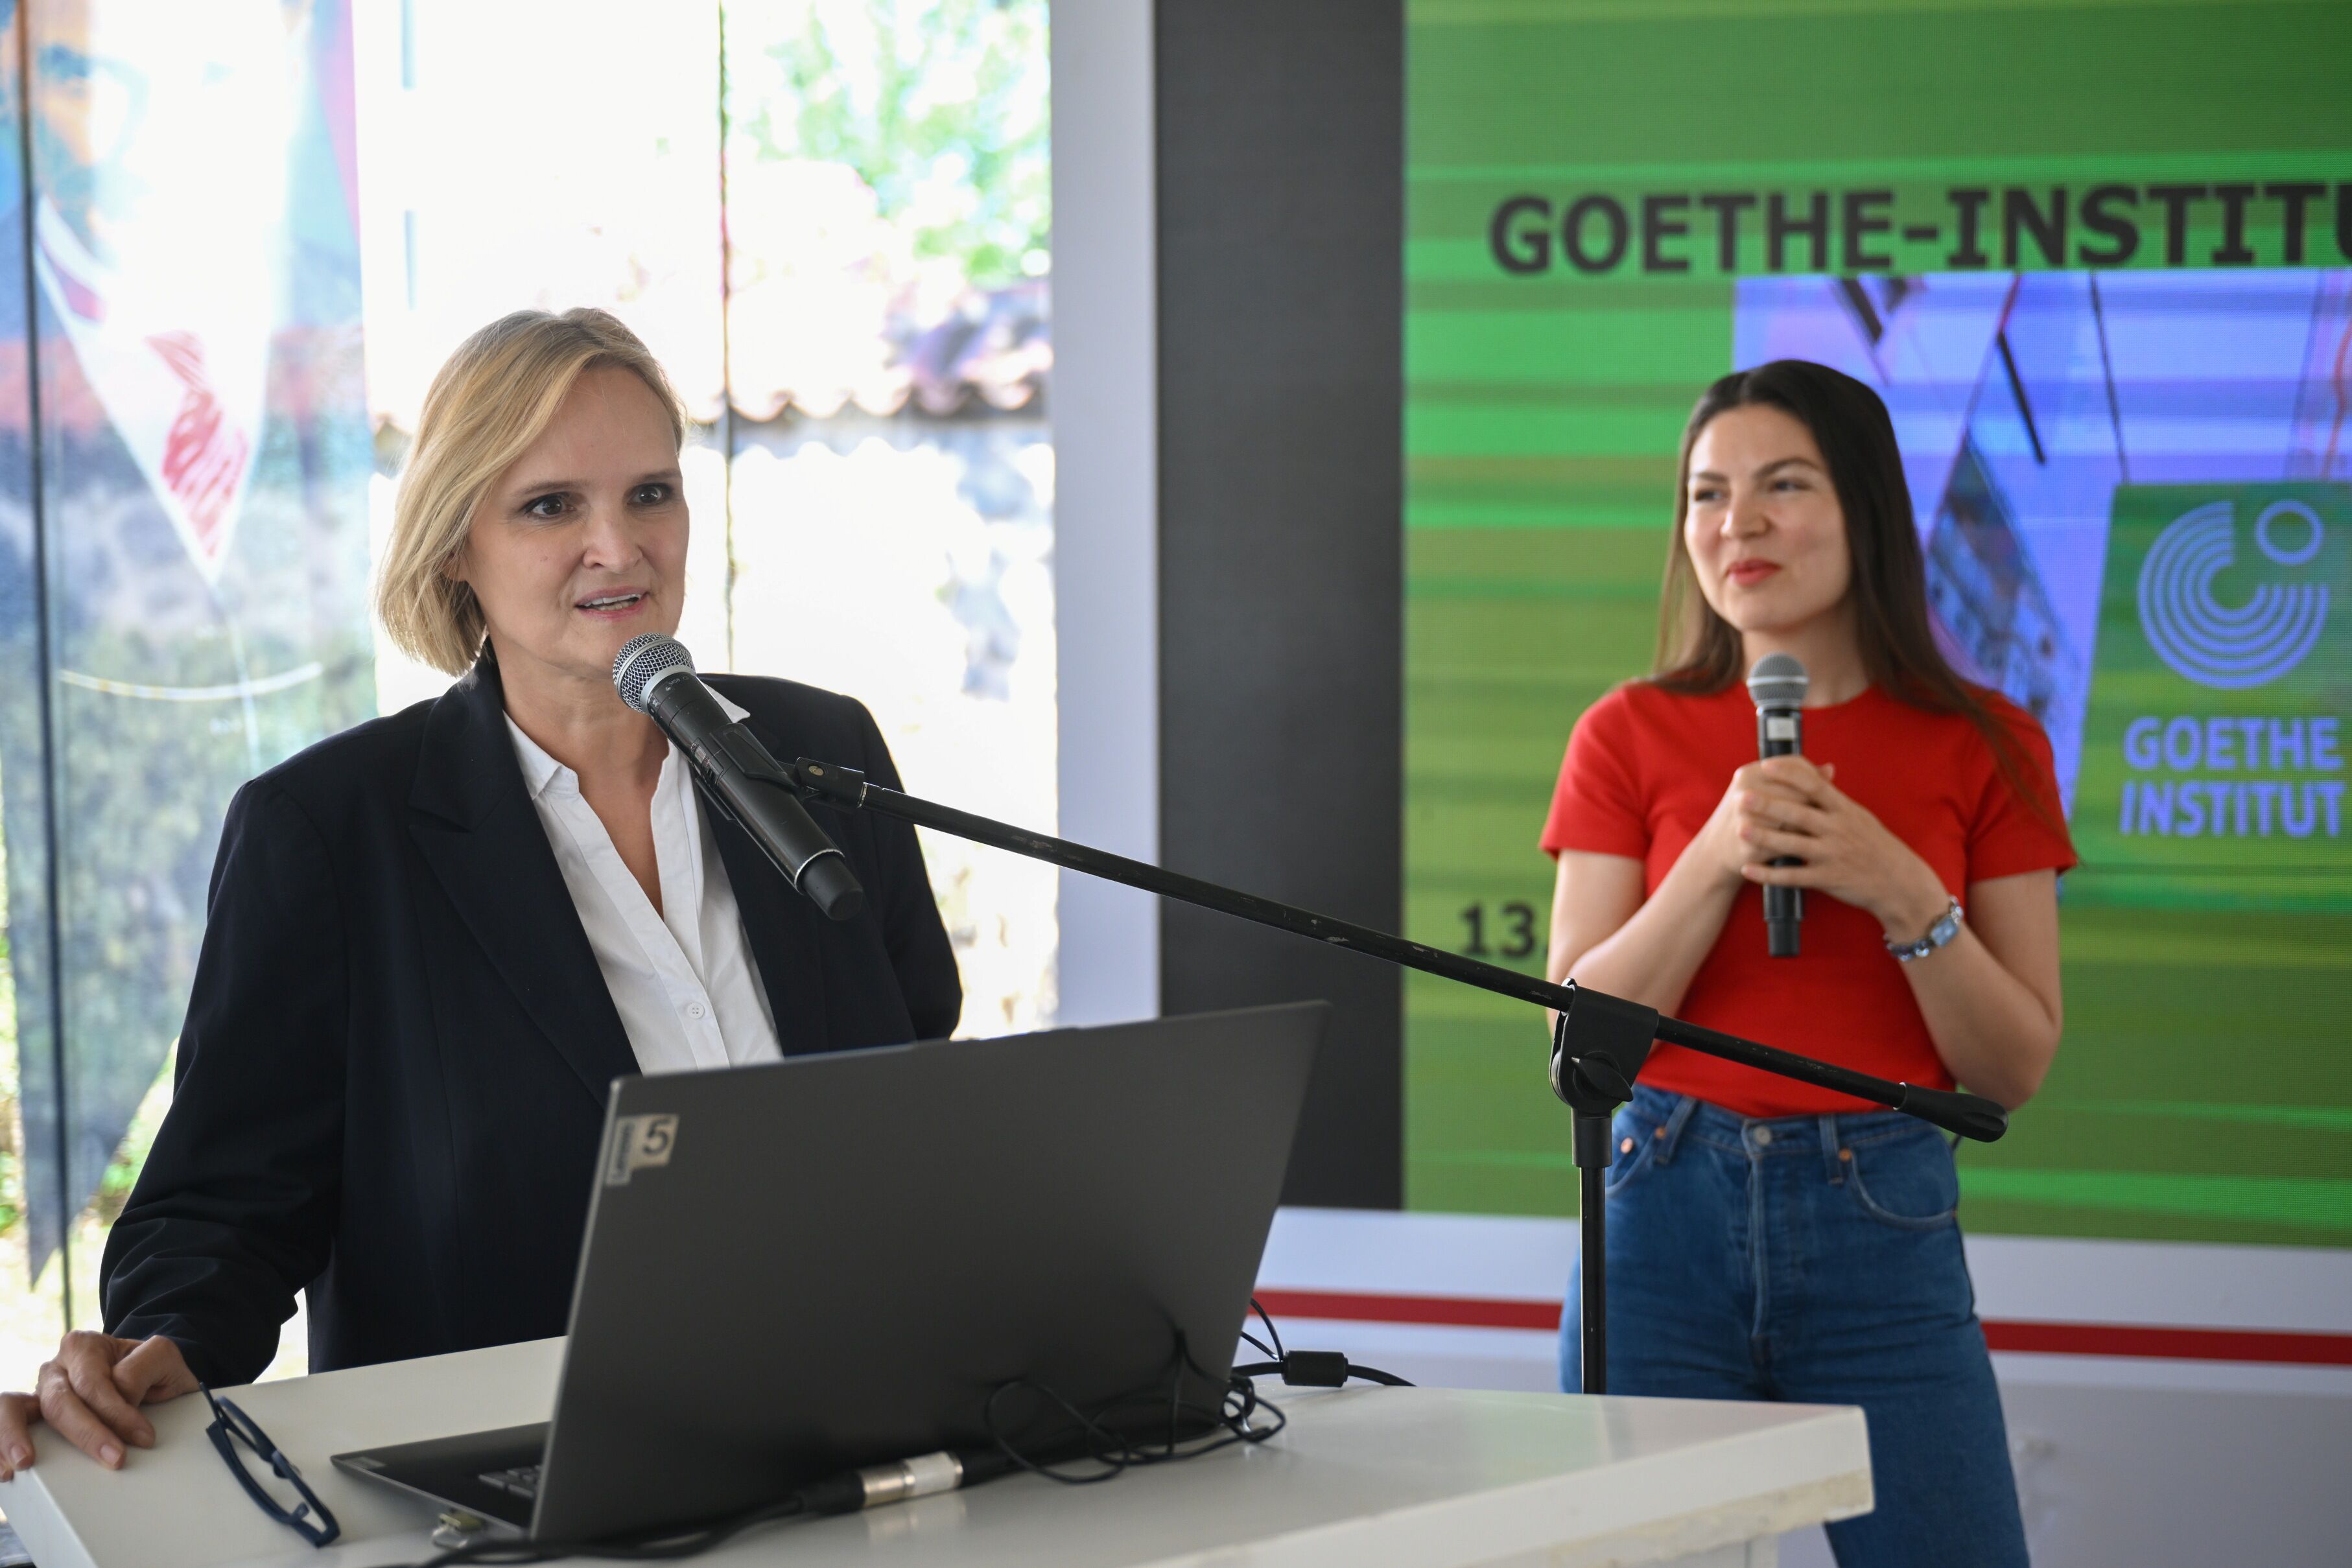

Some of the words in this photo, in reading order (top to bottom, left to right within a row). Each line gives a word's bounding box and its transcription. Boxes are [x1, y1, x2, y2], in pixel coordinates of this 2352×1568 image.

[1490, 184, 2352, 274] GOETHE-INSTIT
[2123, 716, 2344, 771] GOETHE
[2119, 780, 2346, 837] INSTITUT
[642, 1116, 672, 1155] 5
